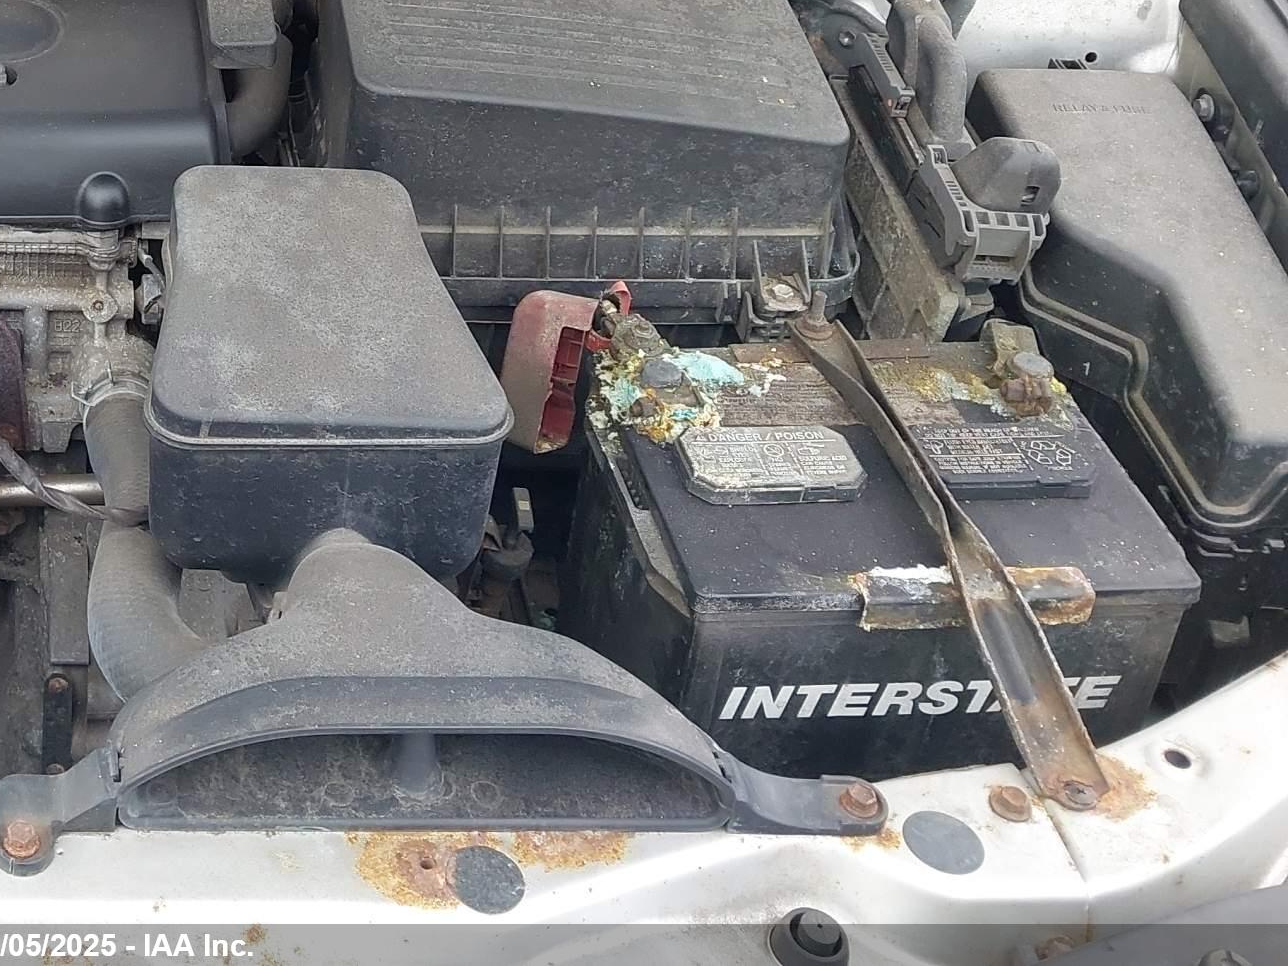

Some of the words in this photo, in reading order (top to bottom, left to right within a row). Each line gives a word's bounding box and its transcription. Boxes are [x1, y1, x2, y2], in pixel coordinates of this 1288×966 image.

[1053, 103, 1097, 112] RELAY
[708, 432, 763, 442] DANGER
[776, 431, 825, 441] POISON
[718, 675, 1123, 721] INTERSTE
